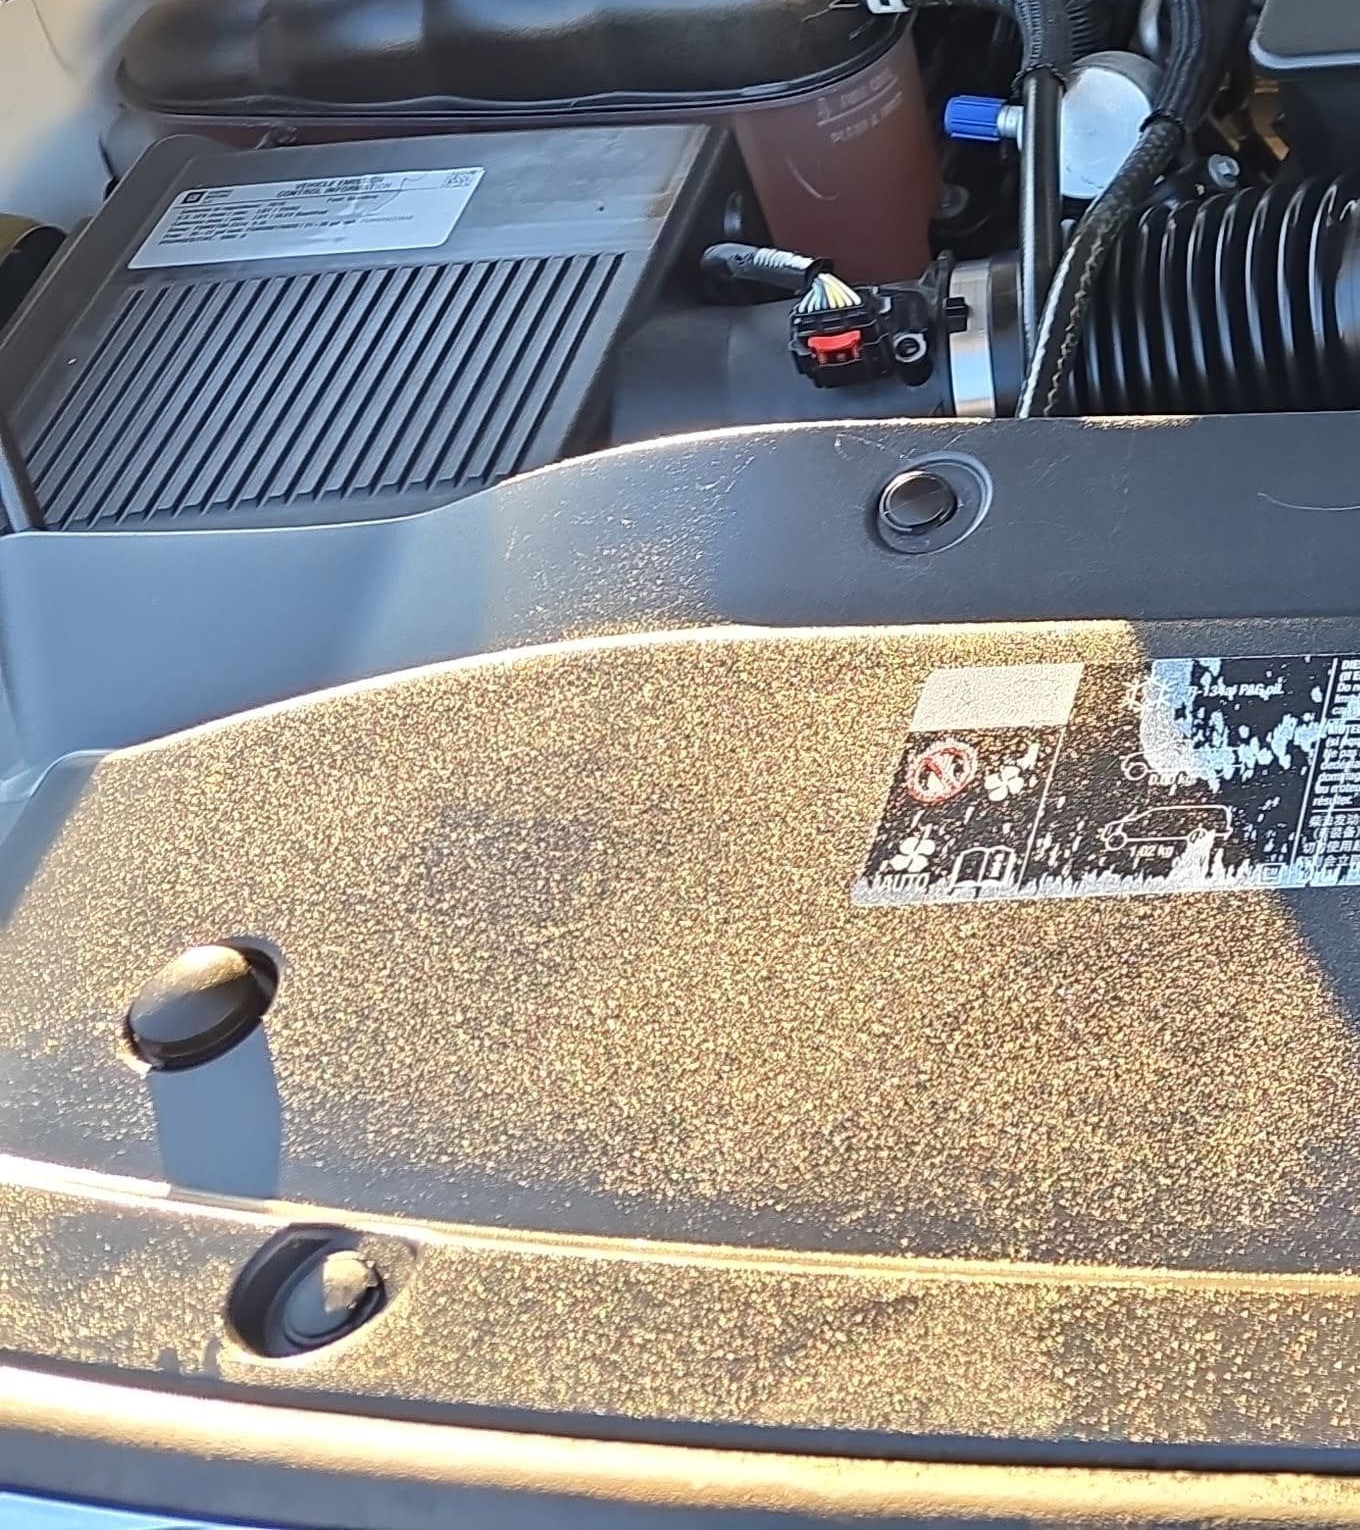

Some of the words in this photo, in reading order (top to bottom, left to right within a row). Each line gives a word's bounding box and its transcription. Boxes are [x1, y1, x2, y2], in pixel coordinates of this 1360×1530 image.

[338, 176, 384, 186] EMISON
[276, 189, 321, 198] CONTROL
[1337, 682, 1350, 692] Do
[1325, 737, 1340, 748] (si
[1339, 748, 1358, 759] pas
[1157, 845, 1174, 858] kg
[879, 873, 930, 891] AUTO
